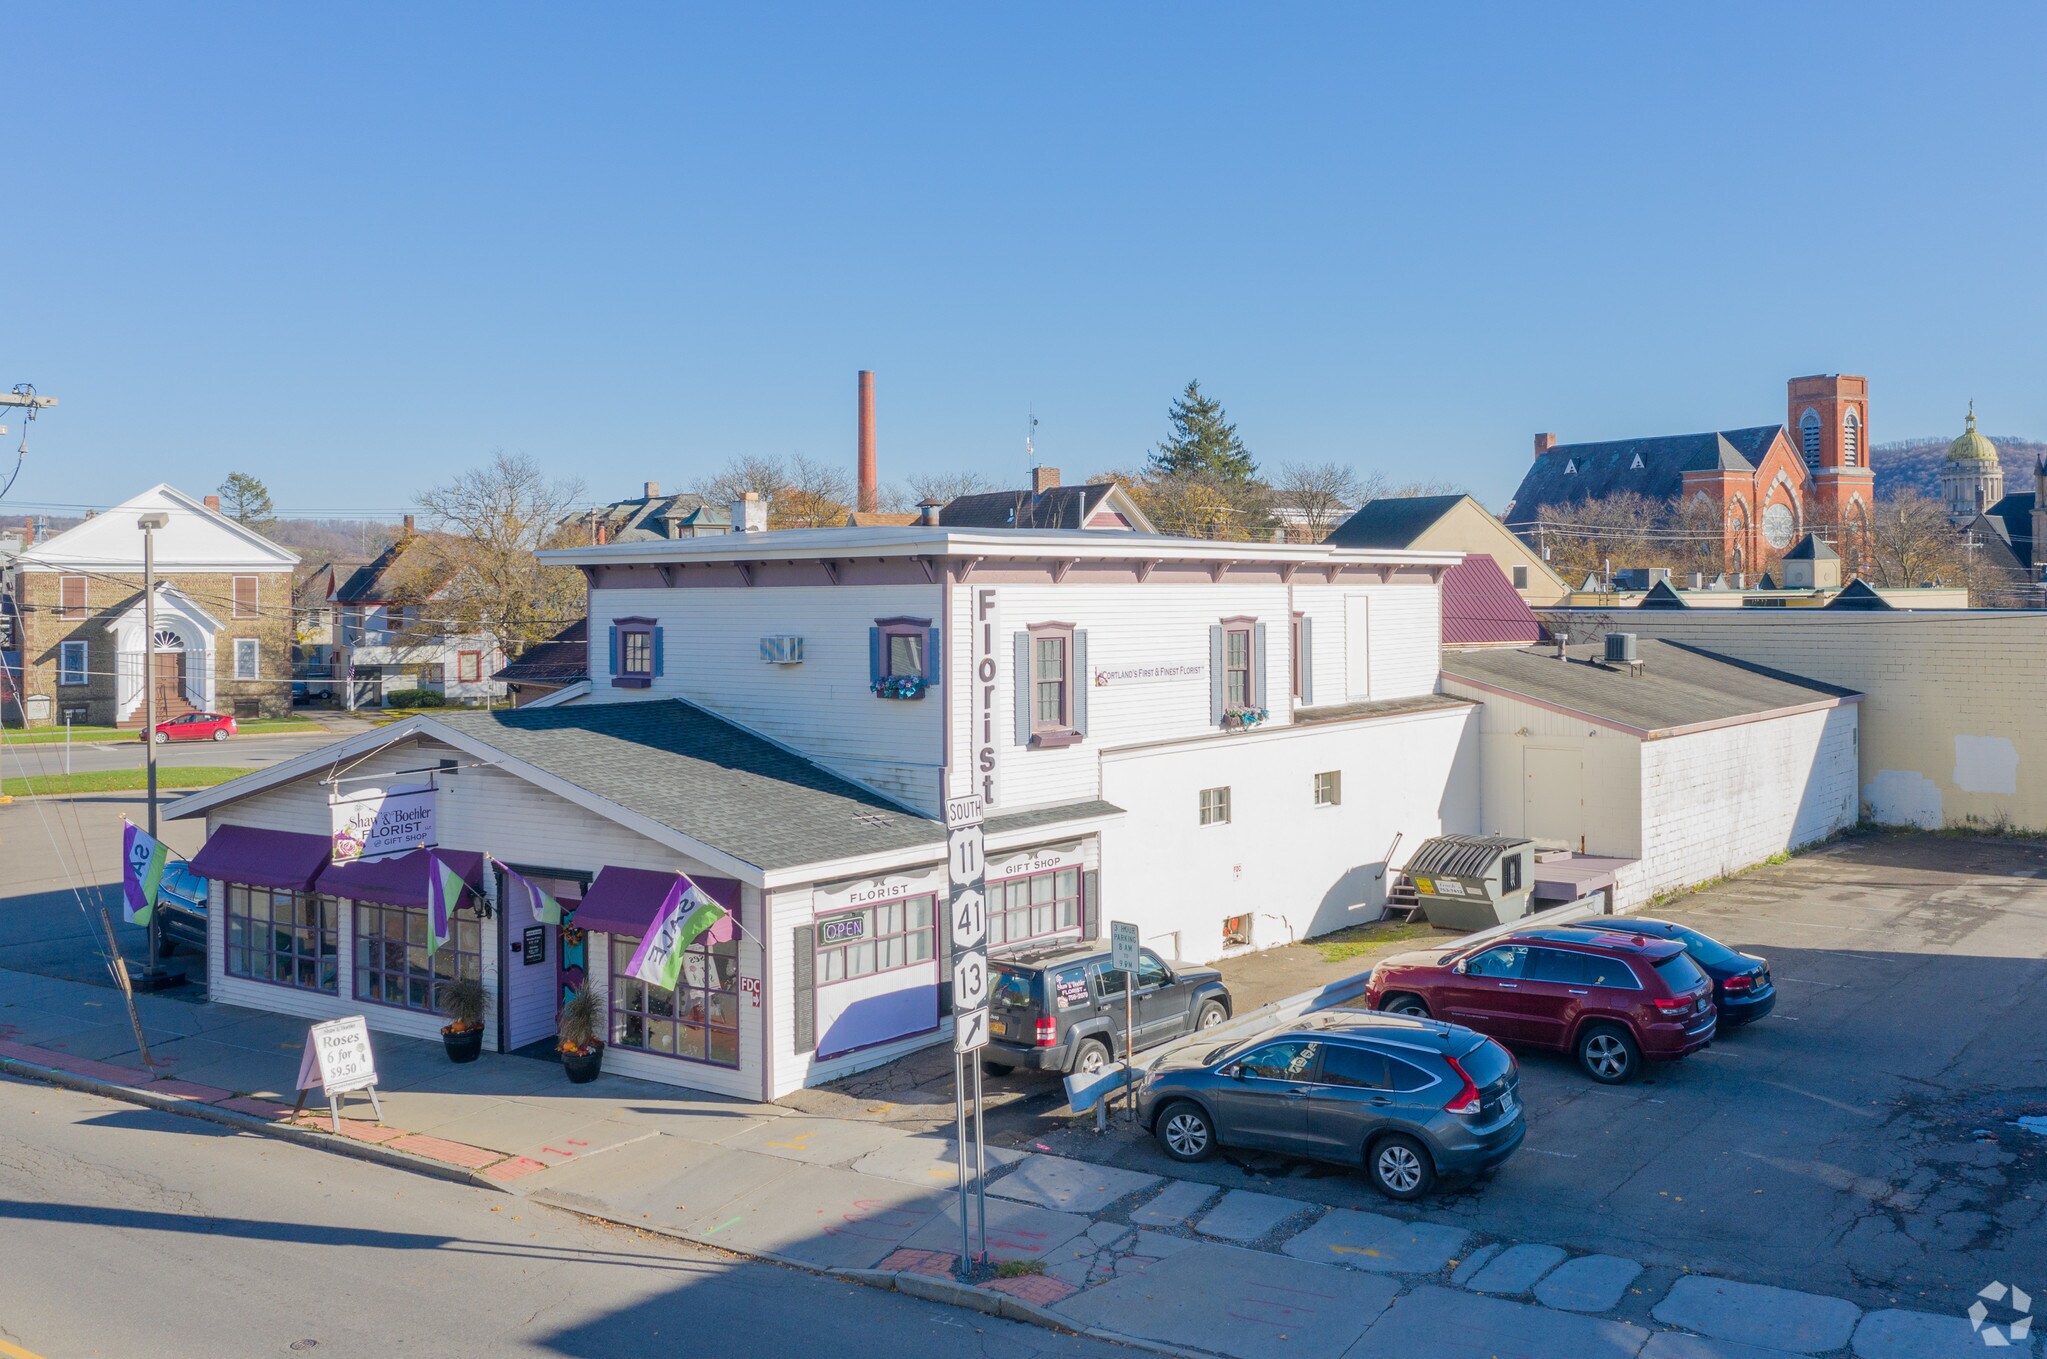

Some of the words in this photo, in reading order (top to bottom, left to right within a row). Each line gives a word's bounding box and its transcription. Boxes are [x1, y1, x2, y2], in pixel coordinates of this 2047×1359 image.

[1154, 667, 1160, 677] &
[978, 588, 997, 805] Florist
[349, 812, 378, 830] Shaw
[382, 812, 391, 826] &
[393, 805, 432, 823] Boehler
[949, 799, 982, 822] SOUTH
[362, 821, 422, 840] FLORIST
[384, 836, 403, 846] GIFT
[405, 832, 428, 842] SHOP
[960, 839, 974, 874] 11
[1005, 862, 1030, 875] GIFT
[1034, 857, 1061, 870] SHOP
[849, 884, 909, 903] FLORIST
[957, 900, 980, 935] 41
[826, 920, 862, 940] OPEN
[1113, 933, 1137, 944] PARKING
[1121, 926, 1136, 934] HOUR
[1124, 944, 1133, 952] AM
[741, 977, 761, 991] FDC
[960, 962, 982, 1000] 13
[323, 1032, 360, 1049] Roses
[327, 1050, 334, 1064] 6
[338, 1048, 353, 1064] for
[330, 1062, 357, 1079] $9.50
